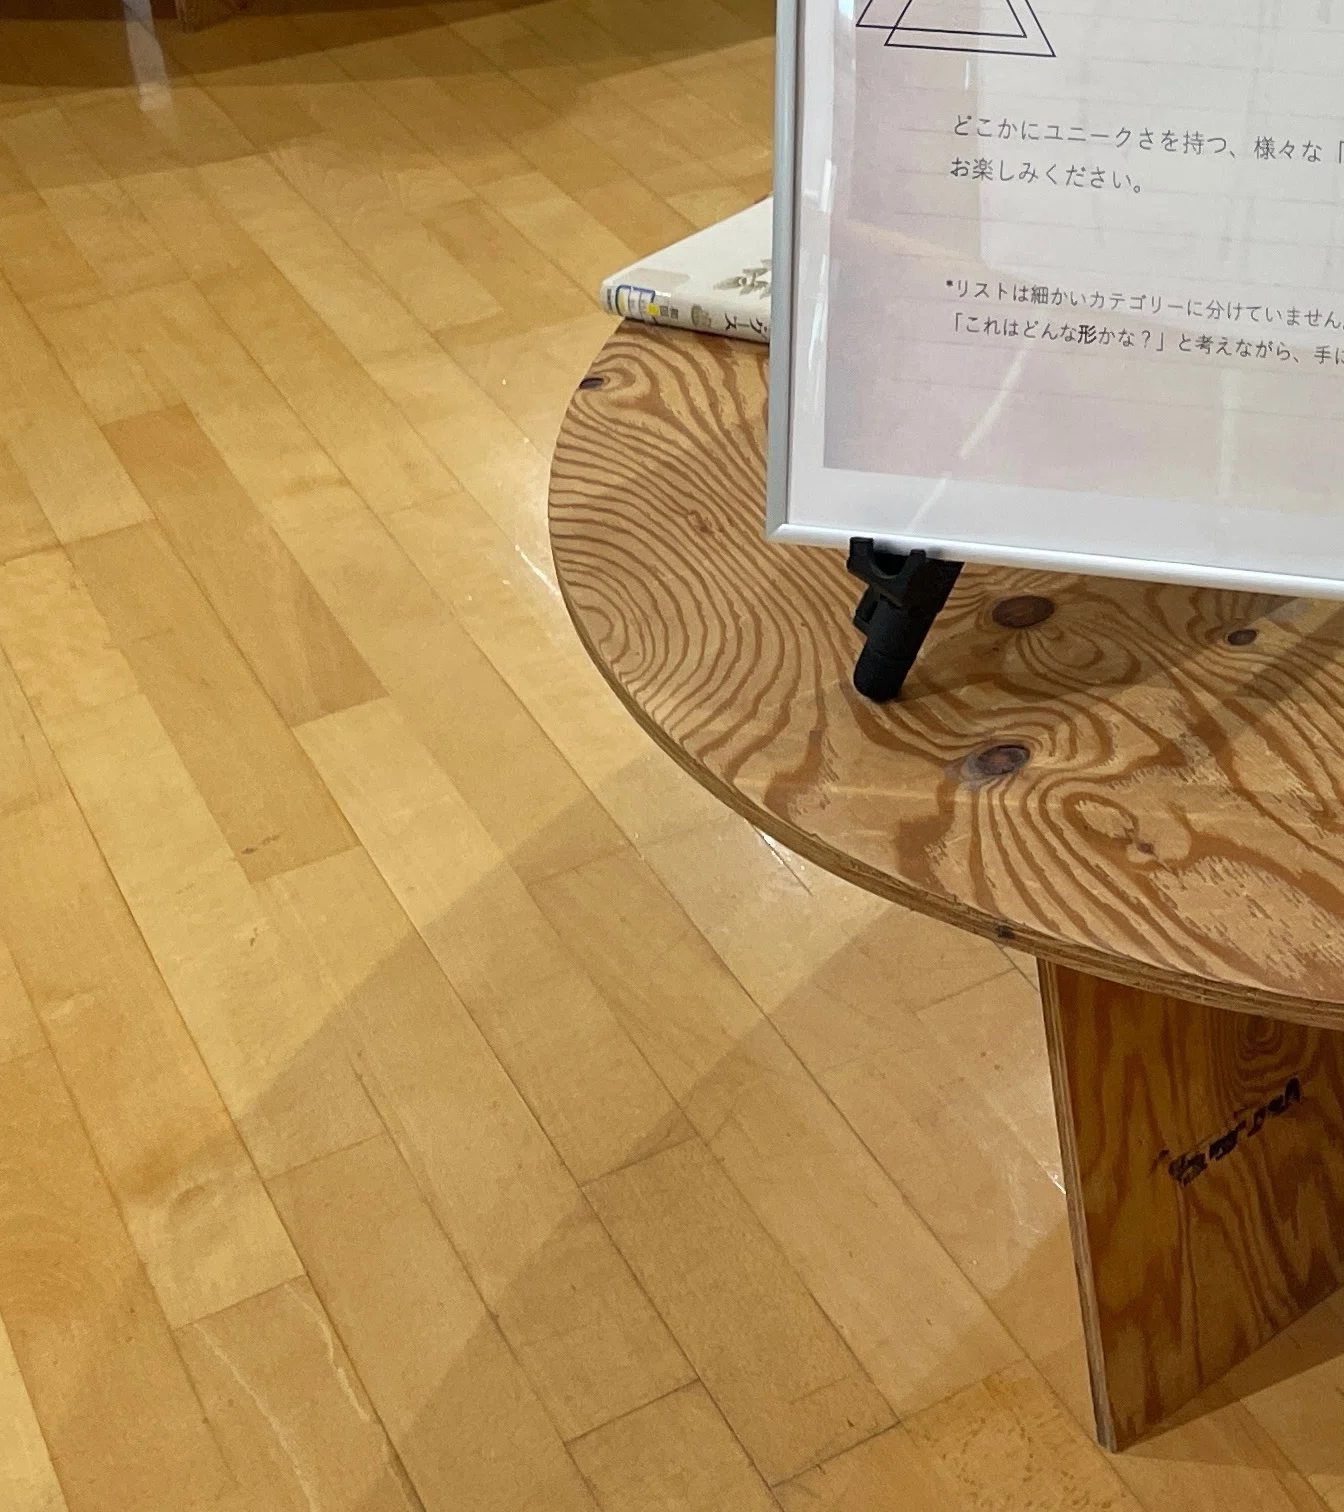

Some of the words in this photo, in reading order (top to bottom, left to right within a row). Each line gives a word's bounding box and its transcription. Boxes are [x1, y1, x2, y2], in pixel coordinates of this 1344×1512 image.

[950, 157, 1140, 193] お楽しみください。
